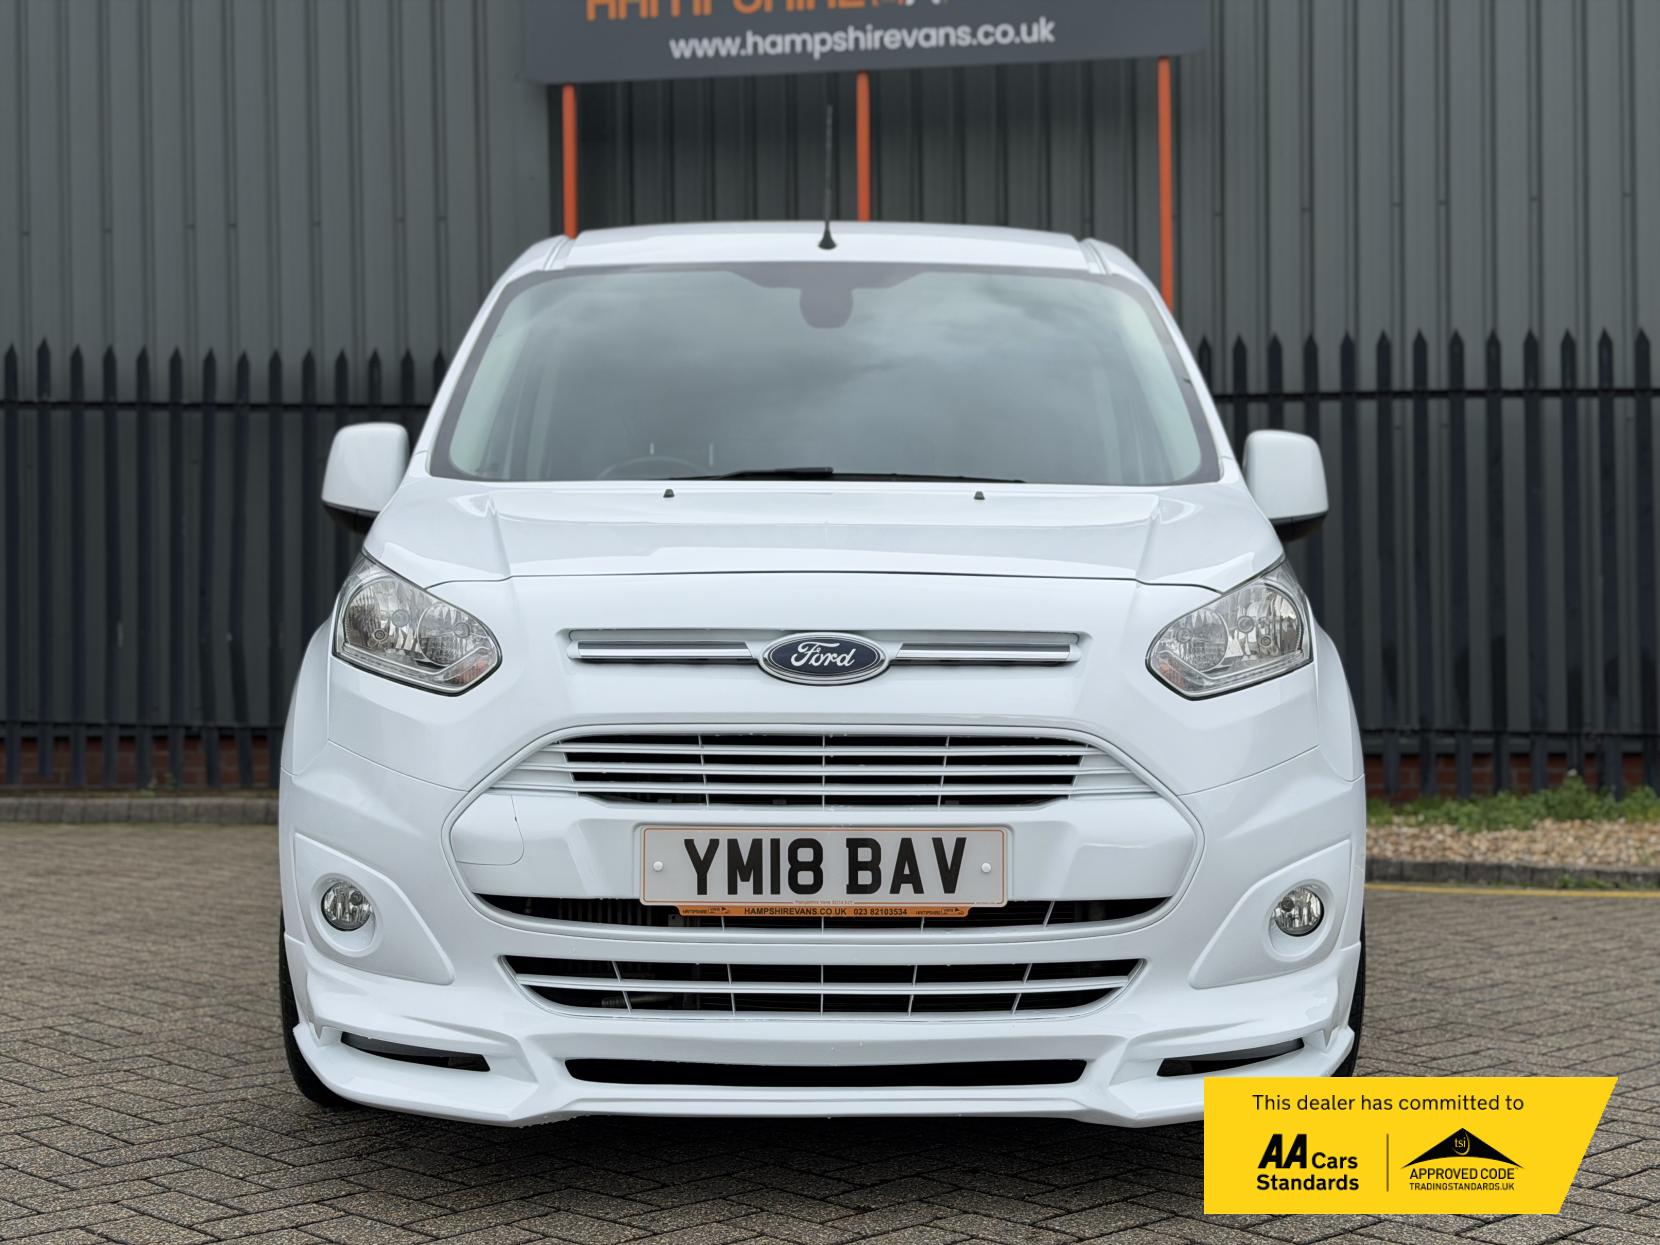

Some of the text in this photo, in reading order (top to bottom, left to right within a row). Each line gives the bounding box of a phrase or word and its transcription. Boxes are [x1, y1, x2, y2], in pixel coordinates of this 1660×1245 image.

[670, 17, 1055, 59] www.hampshirevans.co.uk
[790, 641, 857, 667] Ford
[684, 837, 967, 896] YM18 BAV
[853, 907, 868, 916] 023
[869, 907, 908, 917] 82103534
